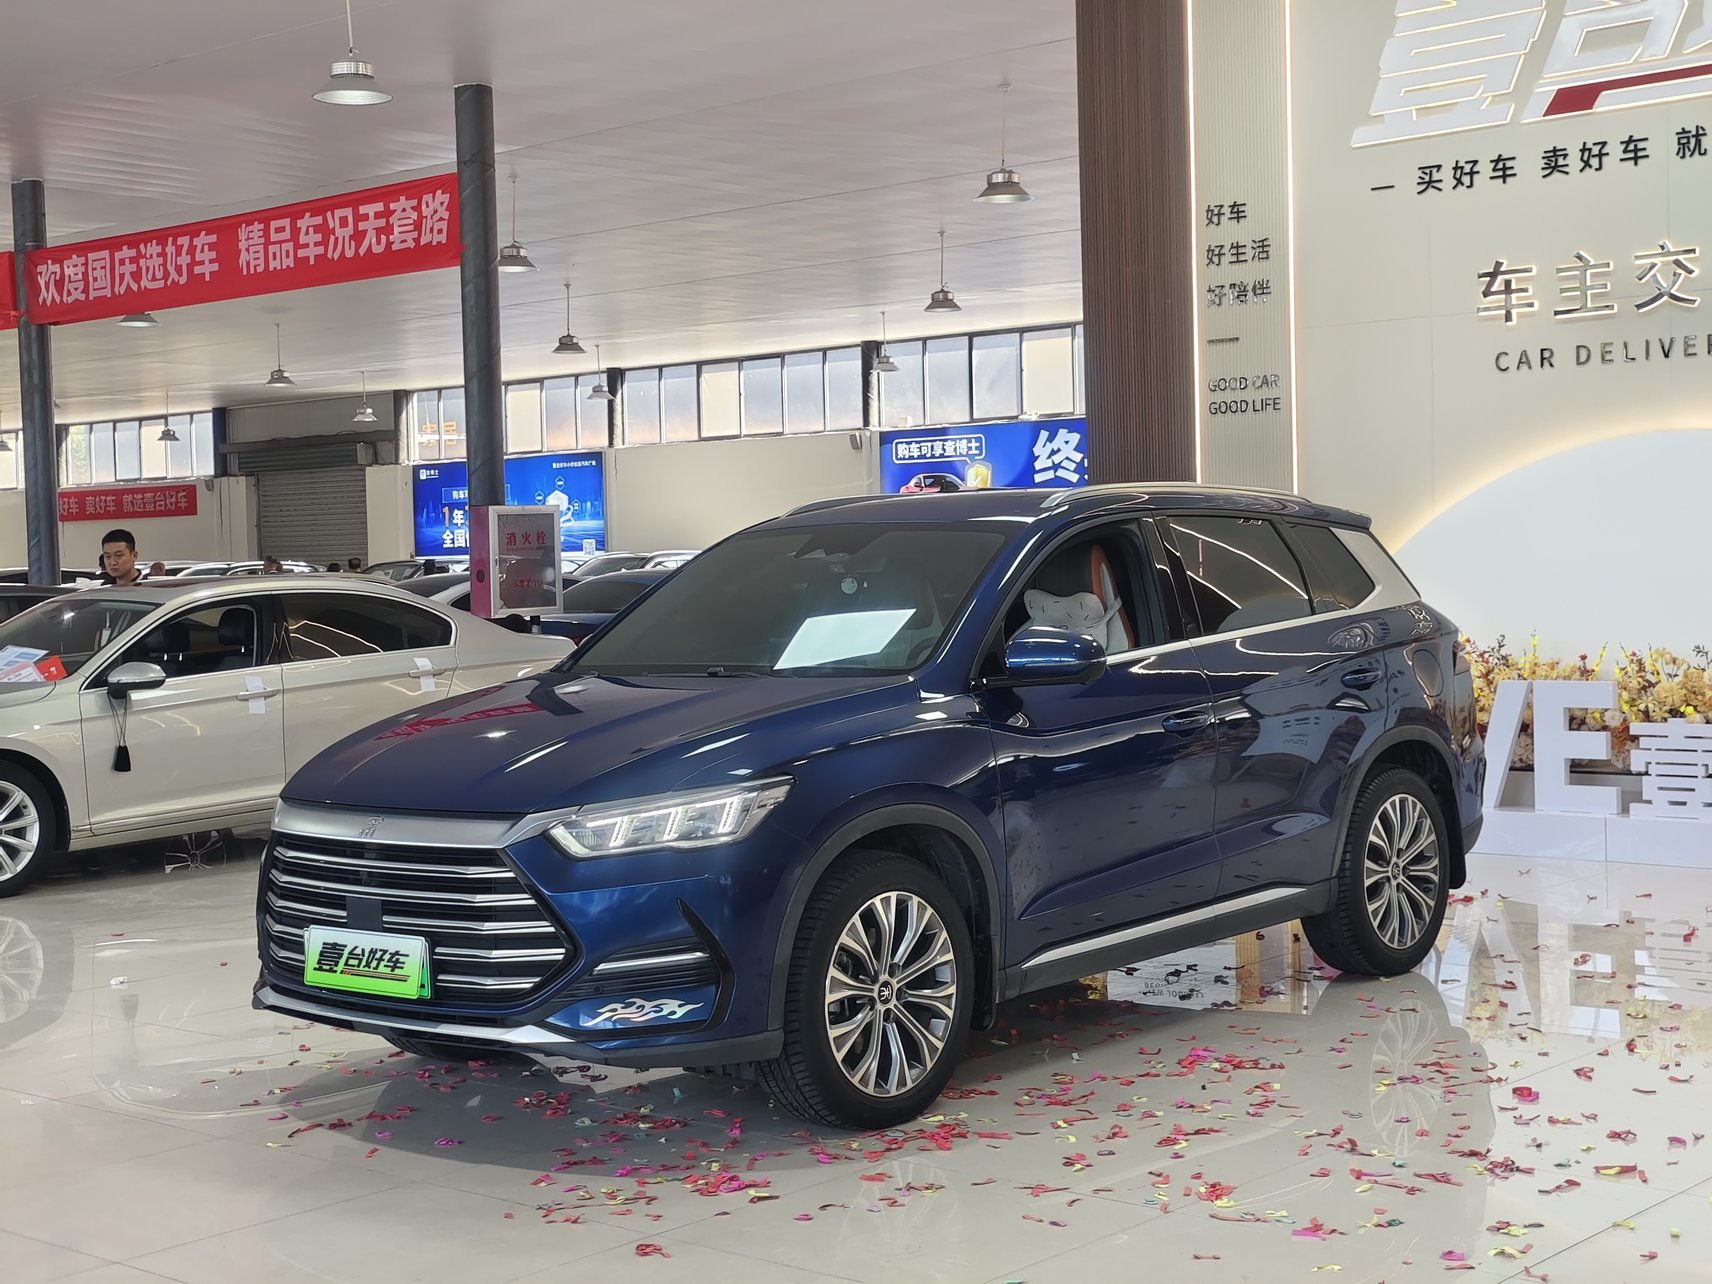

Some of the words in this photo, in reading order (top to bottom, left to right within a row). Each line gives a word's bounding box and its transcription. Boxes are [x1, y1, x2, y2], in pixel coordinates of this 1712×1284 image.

[1416, 153, 1517, 195] 买好车
[1541, 134, 1650, 178] 卖好车
[1675, 124, 1707, 160] 就
[1205, 201, 1247, 227] 好车
[37, 231, 219, 306] 欢度国庆选好车
[238, 190, 451, 275] 精品车况无套路
[1206, 237, 1271, 267] 好生活
[1206, 278, 1272, 308] 好陪伴
[1476, 240, 1701, 326] 车主交
[1495, 347, 1555, 372] CAR
[1208, 376, 1248, 392] GOOD
[1252, 374, 1280, 390] CAR
[1208, 399, 1249, 415] GOOD
[1252, 397, 1281, 412] LIFE
[897, 438, 980, 459] 购车可享查博士
[1032, 428, 1088, 484] 终
[85, 494, 116, 514] 卖好车
[122, 490, 188, 513] 就选壹台好车
[442, 506, 468, 528] 1年
[506, 530, 546, 546] 消火栓
[313, 941, 410, 974] 壹台好车
